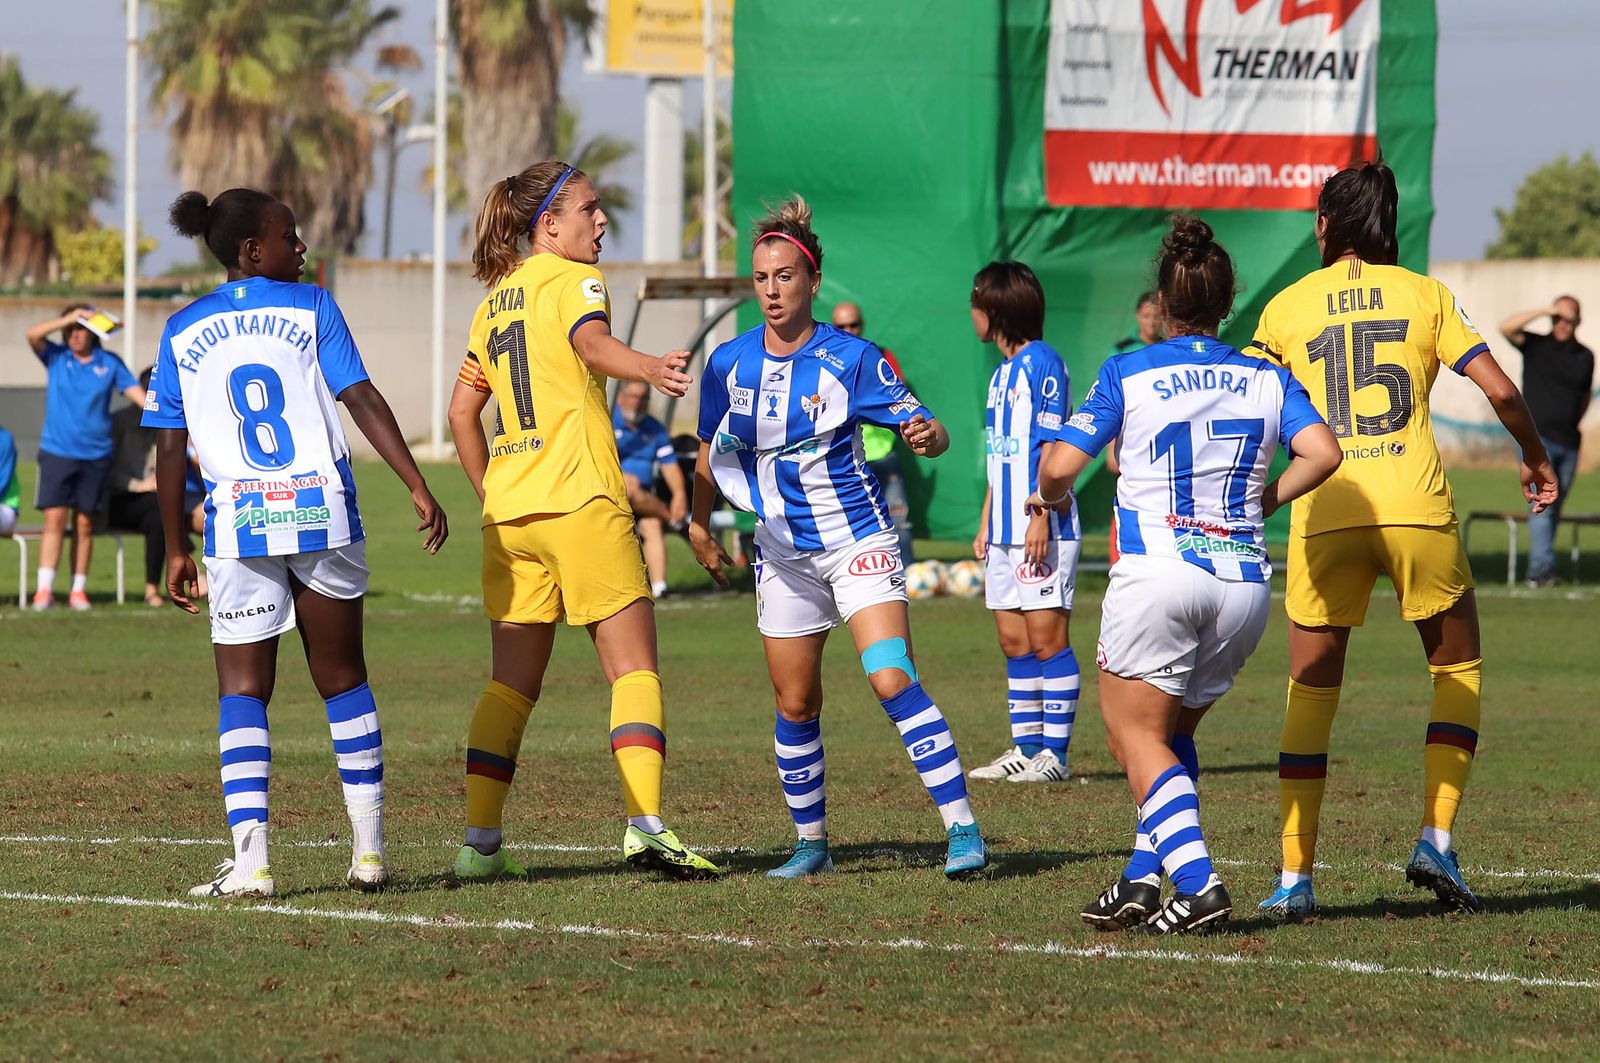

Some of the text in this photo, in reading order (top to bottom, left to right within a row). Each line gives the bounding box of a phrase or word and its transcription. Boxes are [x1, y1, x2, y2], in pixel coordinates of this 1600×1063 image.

[1213, 49, 1359, 80] THERMAN
[1088, 155, 1338, 188] www.therman.com
[1327, 287, 1384, 316] LEILA
[179, 318, 230, 374] FATOU
[235, 314, 313, 353] KANTEH
[486, 319, 537, 437] 11
[1152, 369, 1248, 401] SANDRA
[1305, 319, 1412, 439] 15
[226, 363, 295, 471] 8
[491, 436, 528, 458] unicef
[1344, 441, 1386, 460] nicef
[244, 475, 329, 492] FERTINAGRO
[1150, 418, 1265, 522] 17
[250, 507, 331, 525] Planasa
[1192, 537, 1261, 555] Planasa
[856, 553, 892, 572] KIA
[218, 603, 276, 620] ROMERO
